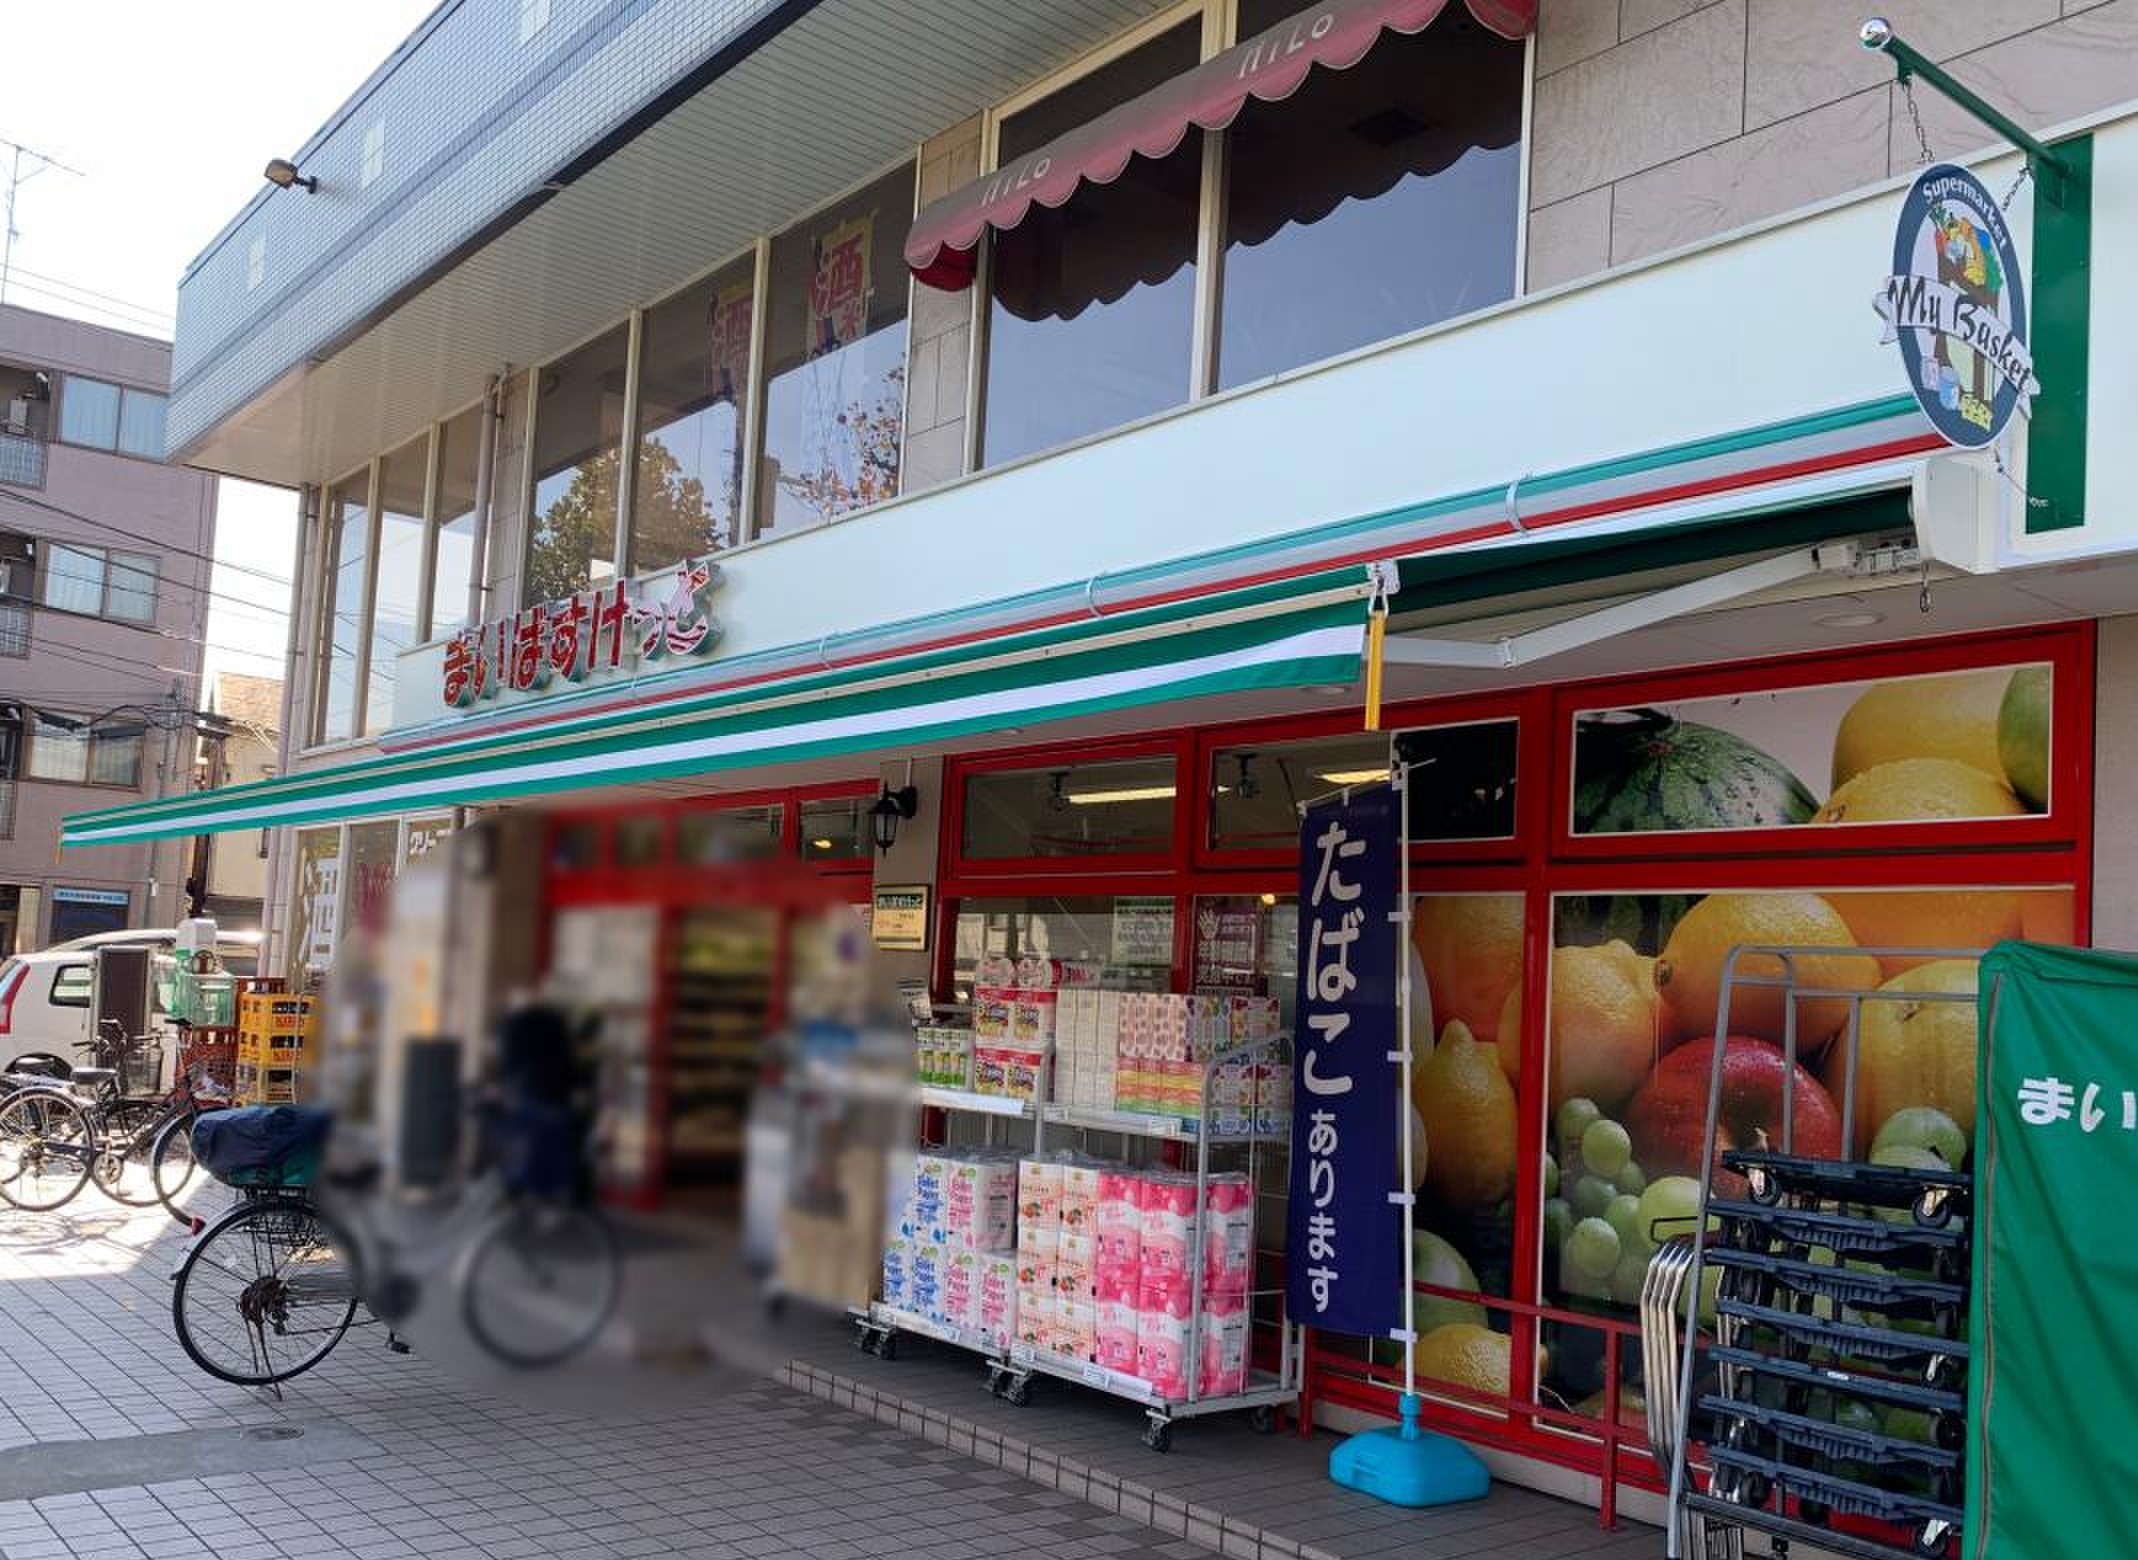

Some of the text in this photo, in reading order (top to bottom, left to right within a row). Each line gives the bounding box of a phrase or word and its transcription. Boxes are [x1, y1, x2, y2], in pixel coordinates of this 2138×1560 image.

[1922, 176, 2007, 250] Supermarket
[1887, 275, 2032, 391] My Basket
[442, 560, 720, 707] まいばすけっと
[2017, 1077, 2138, 1132] まい
